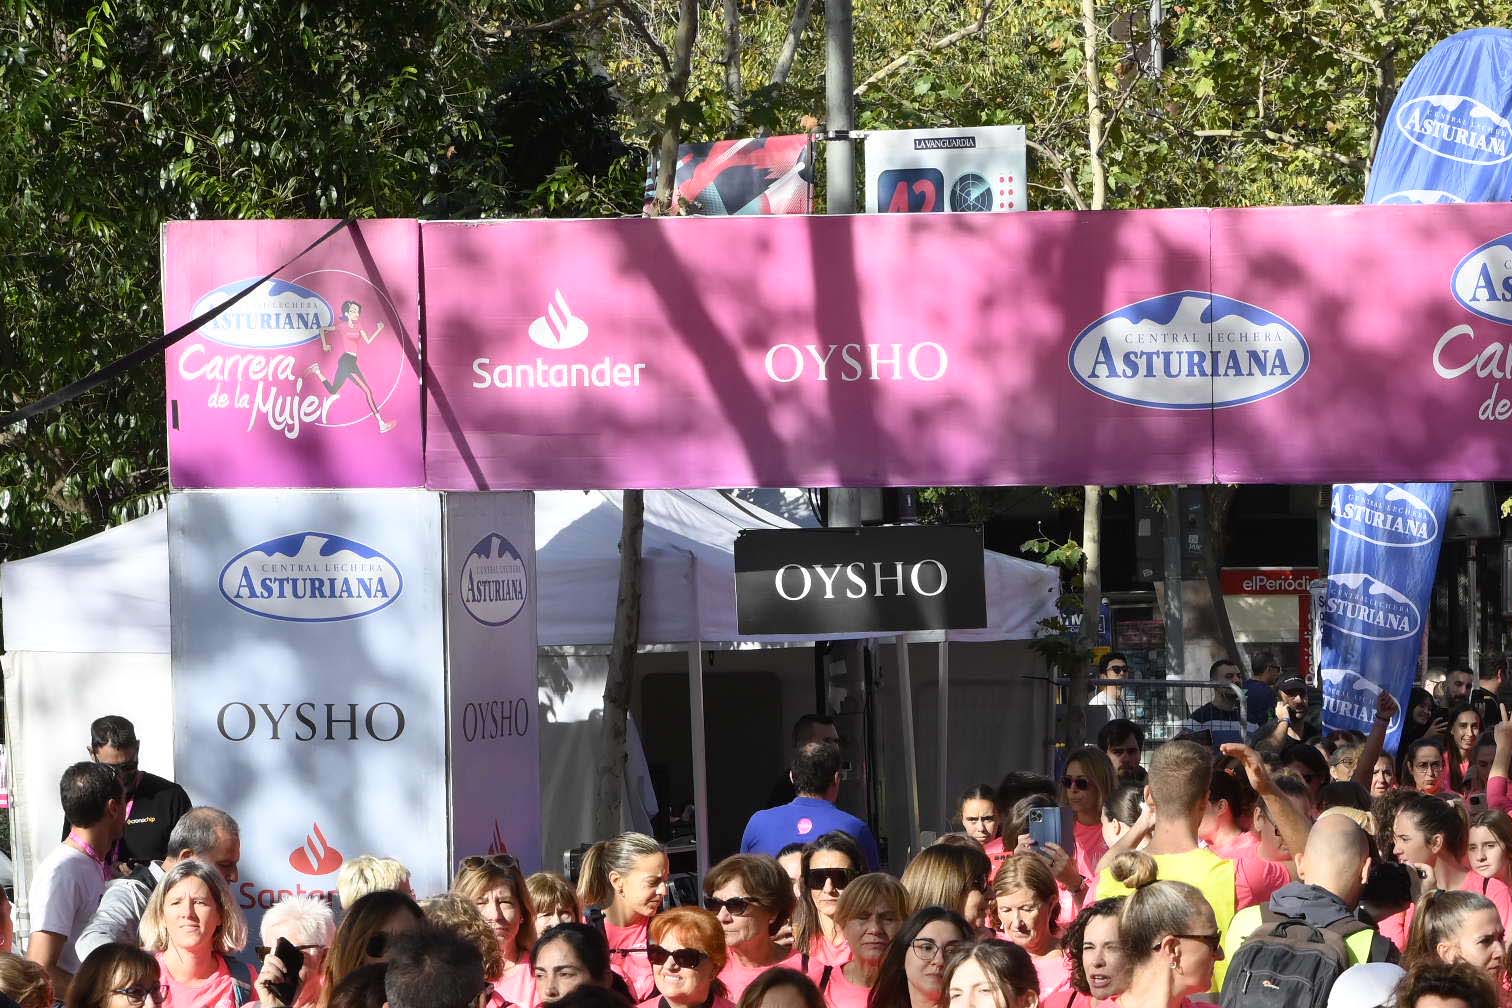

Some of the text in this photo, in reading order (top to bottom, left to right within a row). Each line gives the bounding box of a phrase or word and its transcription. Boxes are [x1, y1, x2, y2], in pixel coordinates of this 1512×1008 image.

[1124, 330, 1283, 344] CENTRAL LECHERA
[178, 343, 296, 381] Carrera
[471, 356, 646, 389] Santander
[764, 341, 948, 384] OYSHO
[1087, 336, 1291, 379] ASTURIANA
[207, 376, 340, 440] de la Mujer
[1478, 389, 1511, 422] de
[1331, 492, 1429, 540] ASTURIANA
[233, 564, 390, 601] ASTURIANA
[261, 562, 383, 574] CENTRAL LECHERA
[466, 567, 524, 603] ASTURIANA
[774, 558, 949, 602] OYSHO
[216, 701, 406, 743] OYSHO
[462, 698, 529, 744] OYSHO
